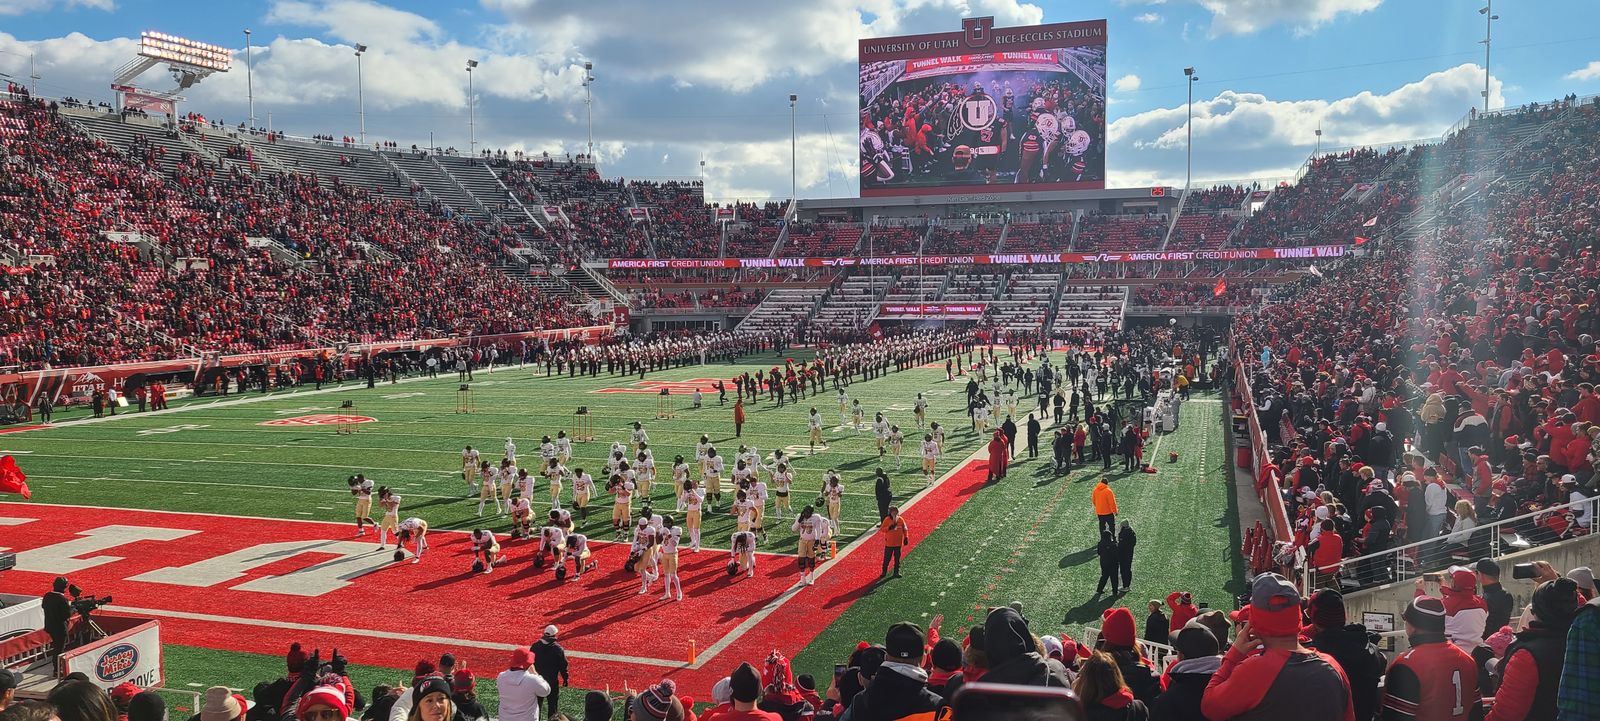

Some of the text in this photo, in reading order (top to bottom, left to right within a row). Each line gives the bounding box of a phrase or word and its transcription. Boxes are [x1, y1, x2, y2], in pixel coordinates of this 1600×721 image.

[995, 28, 1102, 44] RICE-ECCLES STADIUM
[864, 39, 960, 54] UNIVERSITY OF UTAH
[912, 55, 962, 69] TUNNEL WALK
[1002, 52, 1052, 60] TUNNEL WALK
[859, 257, 894, 265] AMERICA
[895, 257, 918, 265] FIRST
[919, 257, 949, 265] CREDIT
[989, 255, 1030, 264] TUNNEL
[1031, 254, 1061, 263] WALK
[1167, 252, 1195, 260] FIRST
[1196, 252, 1228, 260] CREDIT
[1229, 251, 1258, 259] UNION
[1273, 248, 1315, 258] TUNNEL
[612, 260, 646, 268] AMERICA
[647, 260, 670, 268] FIRST
[671, 260, 700, 268] CREDIT
[740, 259, 777, 267] TUNNEL
[778, 258, 805, 267] WALK
[72, 383, 105, 392] UTAH
[1452, 670, 1464, 716] 1
